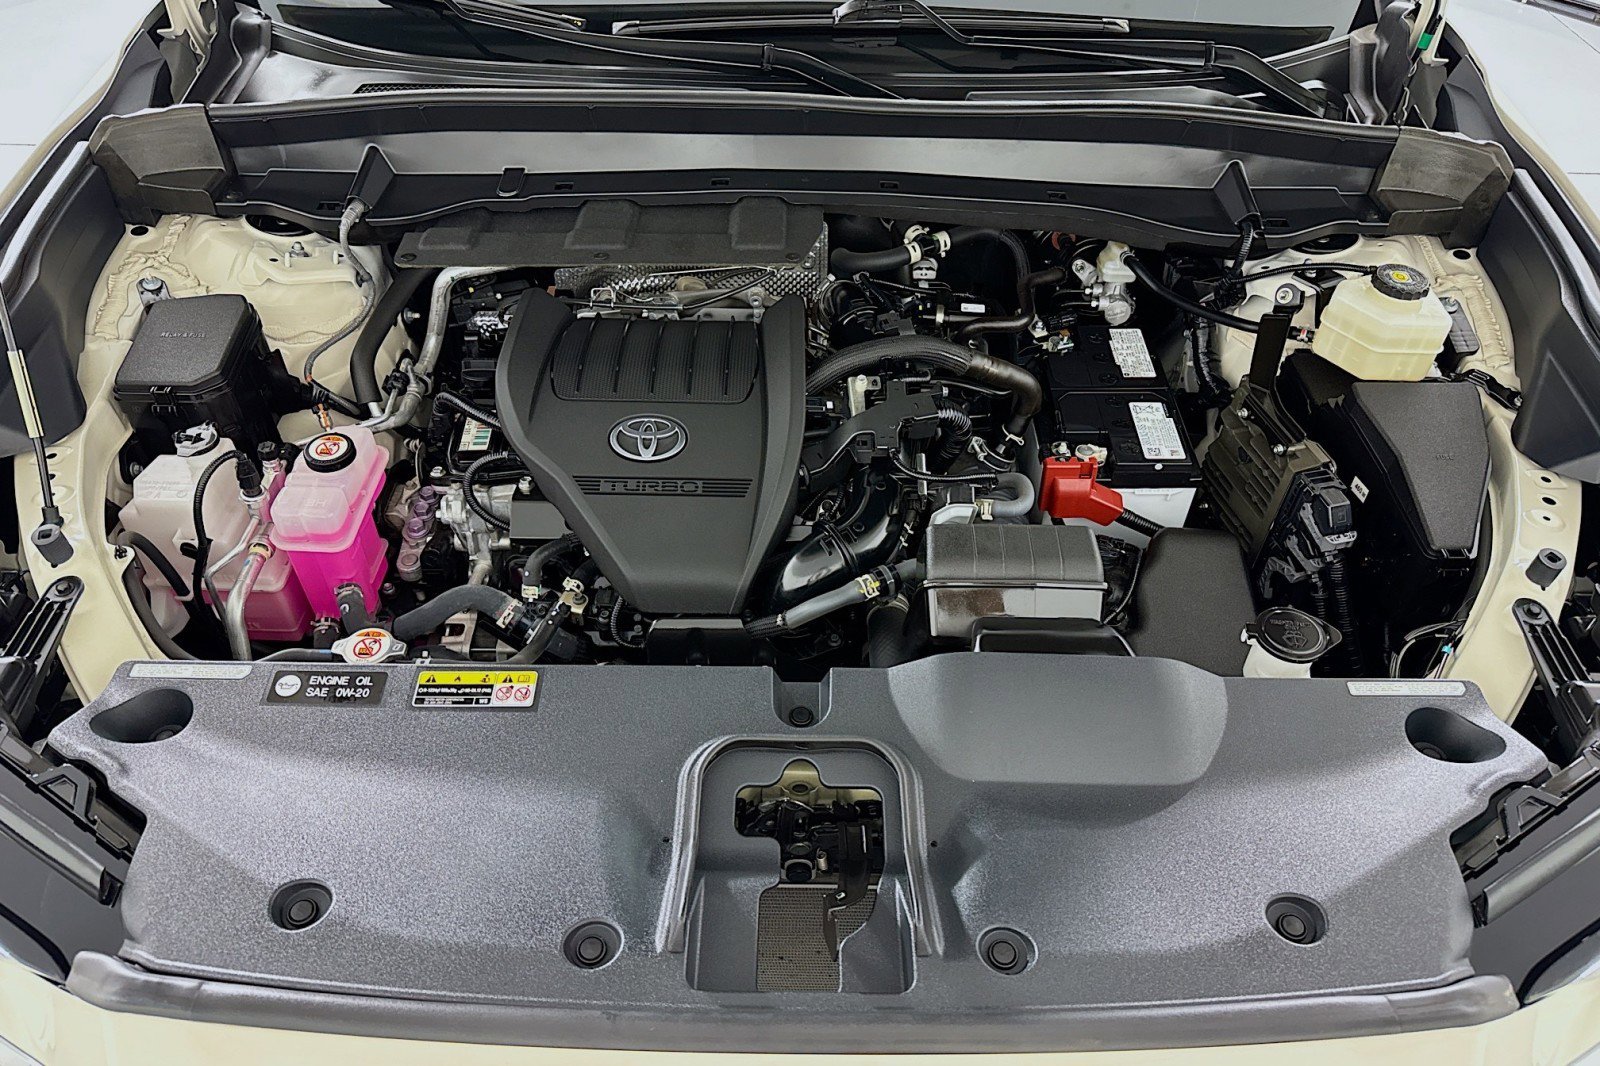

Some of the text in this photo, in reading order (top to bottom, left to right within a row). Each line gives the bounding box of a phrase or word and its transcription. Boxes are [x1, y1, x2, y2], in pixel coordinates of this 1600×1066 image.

[603, 480, 699, 493] TURBO
[309, 675, 374, 686] ENGINE OIL
[305, 687, 370, 698] SAE 0W-20
